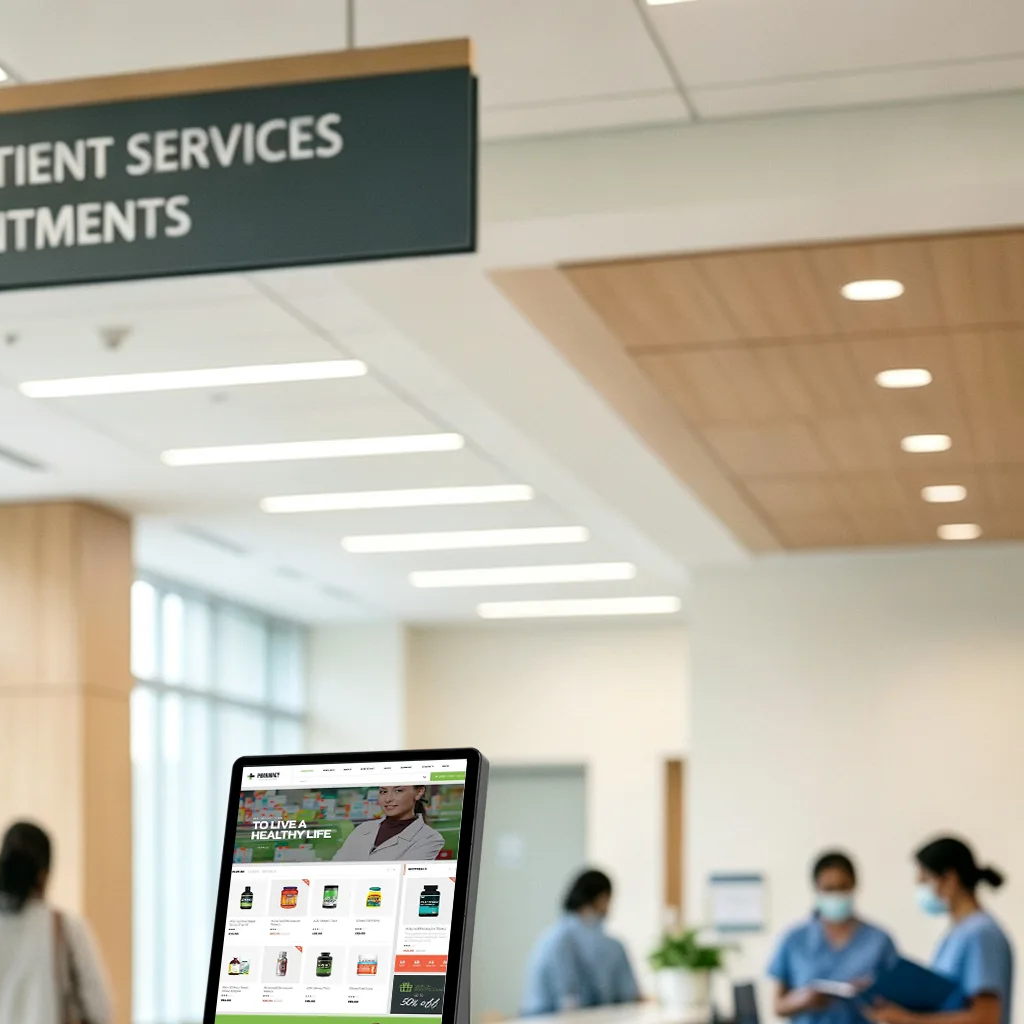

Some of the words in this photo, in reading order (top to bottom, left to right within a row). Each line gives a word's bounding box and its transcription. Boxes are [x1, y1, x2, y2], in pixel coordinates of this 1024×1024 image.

[126, 112, 344, 177] SERVICES
[252, 820, 270, 830] TO
[270, 820, 297, 829] LIVE
[298, 820, 307, 828] A
[251, 830, 306, 840] HEALTHY
[306, 830, 332, 838] LIFE
[399, 997, 419, 1007] 50%
[420, 998, 440, 1009] off
